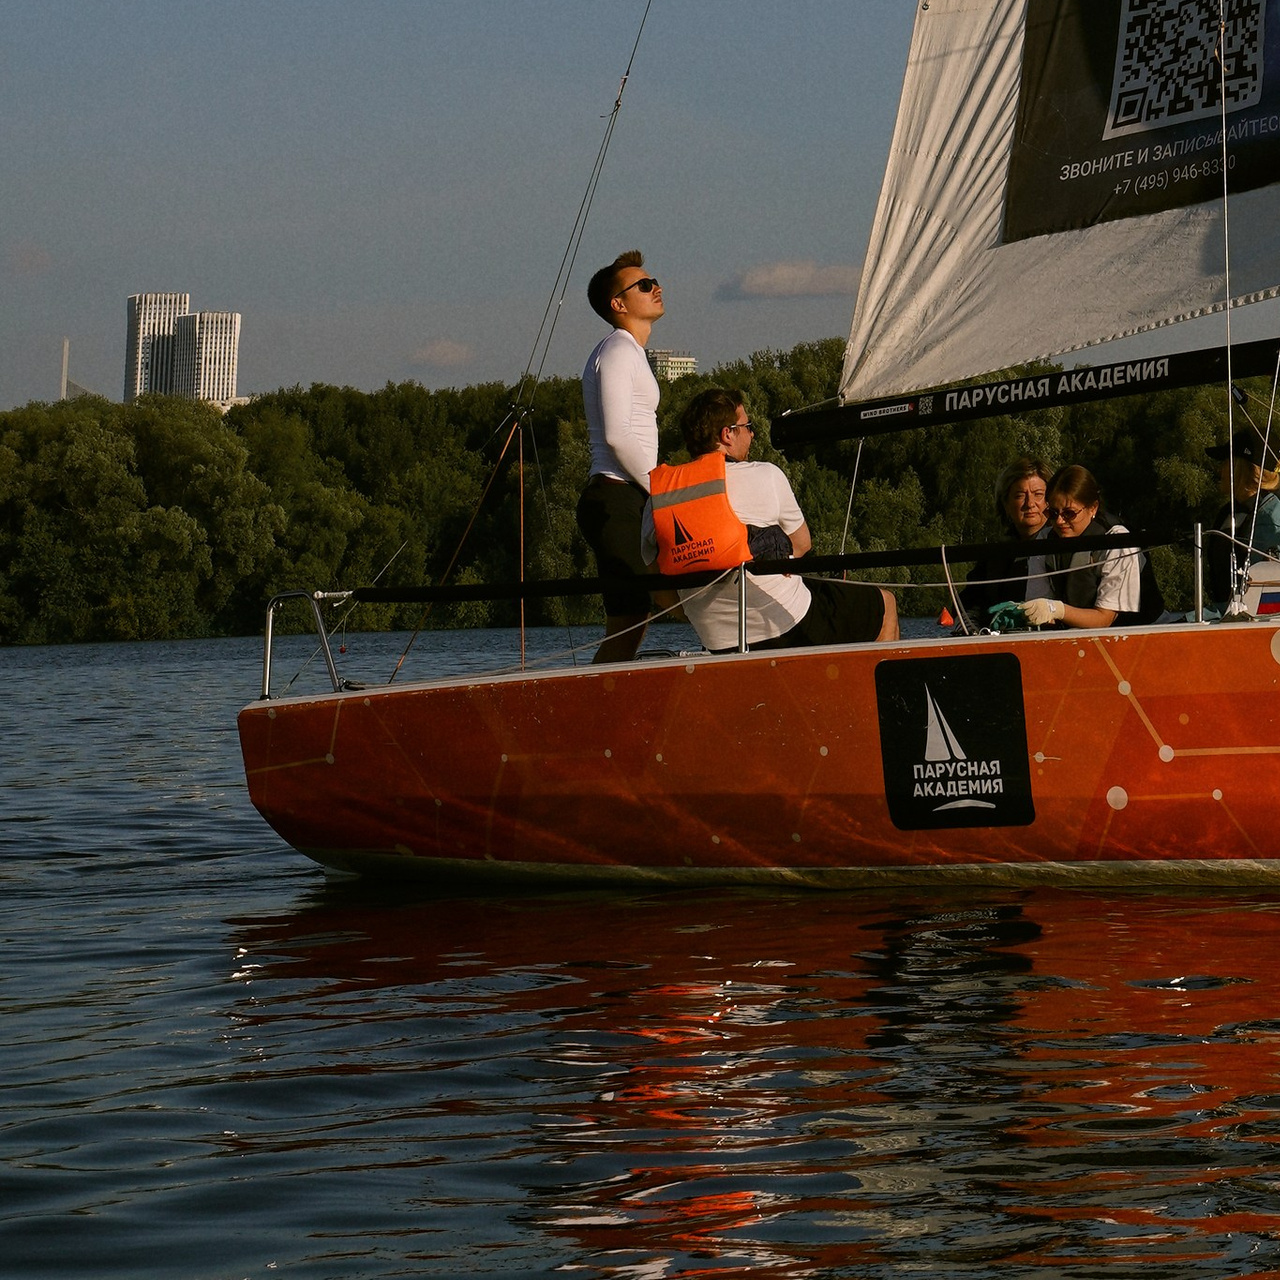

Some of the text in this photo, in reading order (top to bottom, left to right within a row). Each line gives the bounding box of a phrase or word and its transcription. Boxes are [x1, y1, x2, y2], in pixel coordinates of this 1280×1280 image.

[1059, 149, 1135, 181] ЗВОНИТЕ
[1137, 147, 1149, 164] И
[1113, 179, 1132, 195] +7
[1134, 169, 1169, 195] (495)
[945, 358, 1169, 411] ПАРУСНАЯ АКАДЕМИЯ
[862, 410, 878, 418] WIND
[671, 537, 714, 556] ПАРУСНАЯ
[673, 546, 715, 564] АКАДЕМИЯ
[913, 760, 1001, 779] ПАРУСНАЯ
[913, 779, 1004, 797] АКАДЕМИЯ
